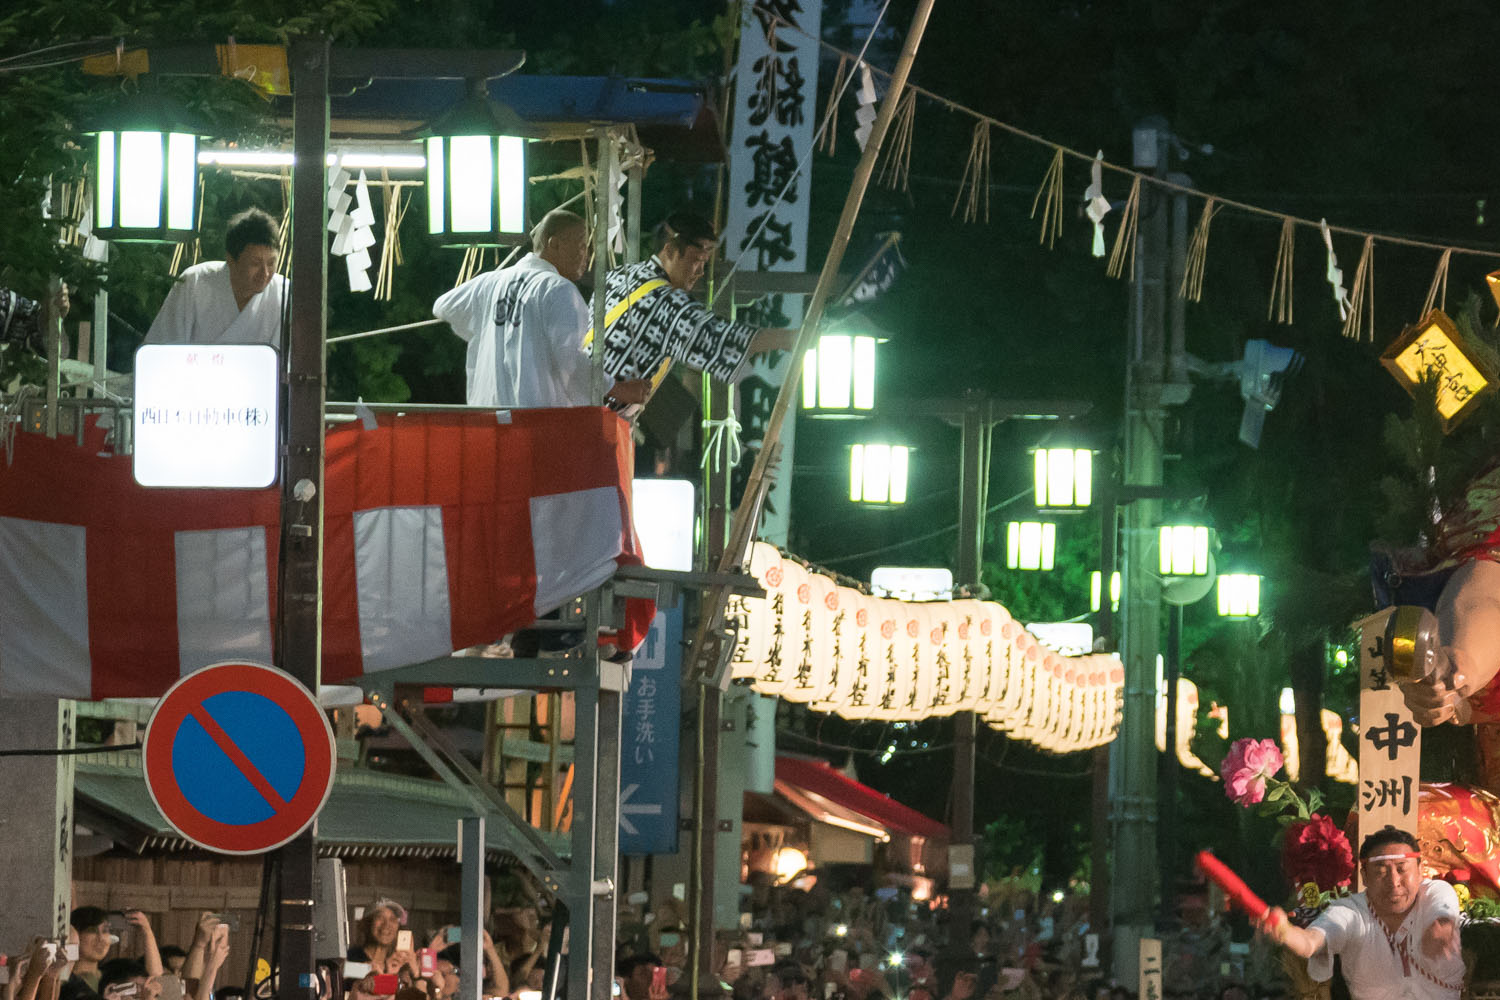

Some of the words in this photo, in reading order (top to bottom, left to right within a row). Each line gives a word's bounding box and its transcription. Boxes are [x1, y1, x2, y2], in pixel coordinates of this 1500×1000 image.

[634, 676, 657, 764] お手洗い
[1362, 712, 1418, 816] 中洲
